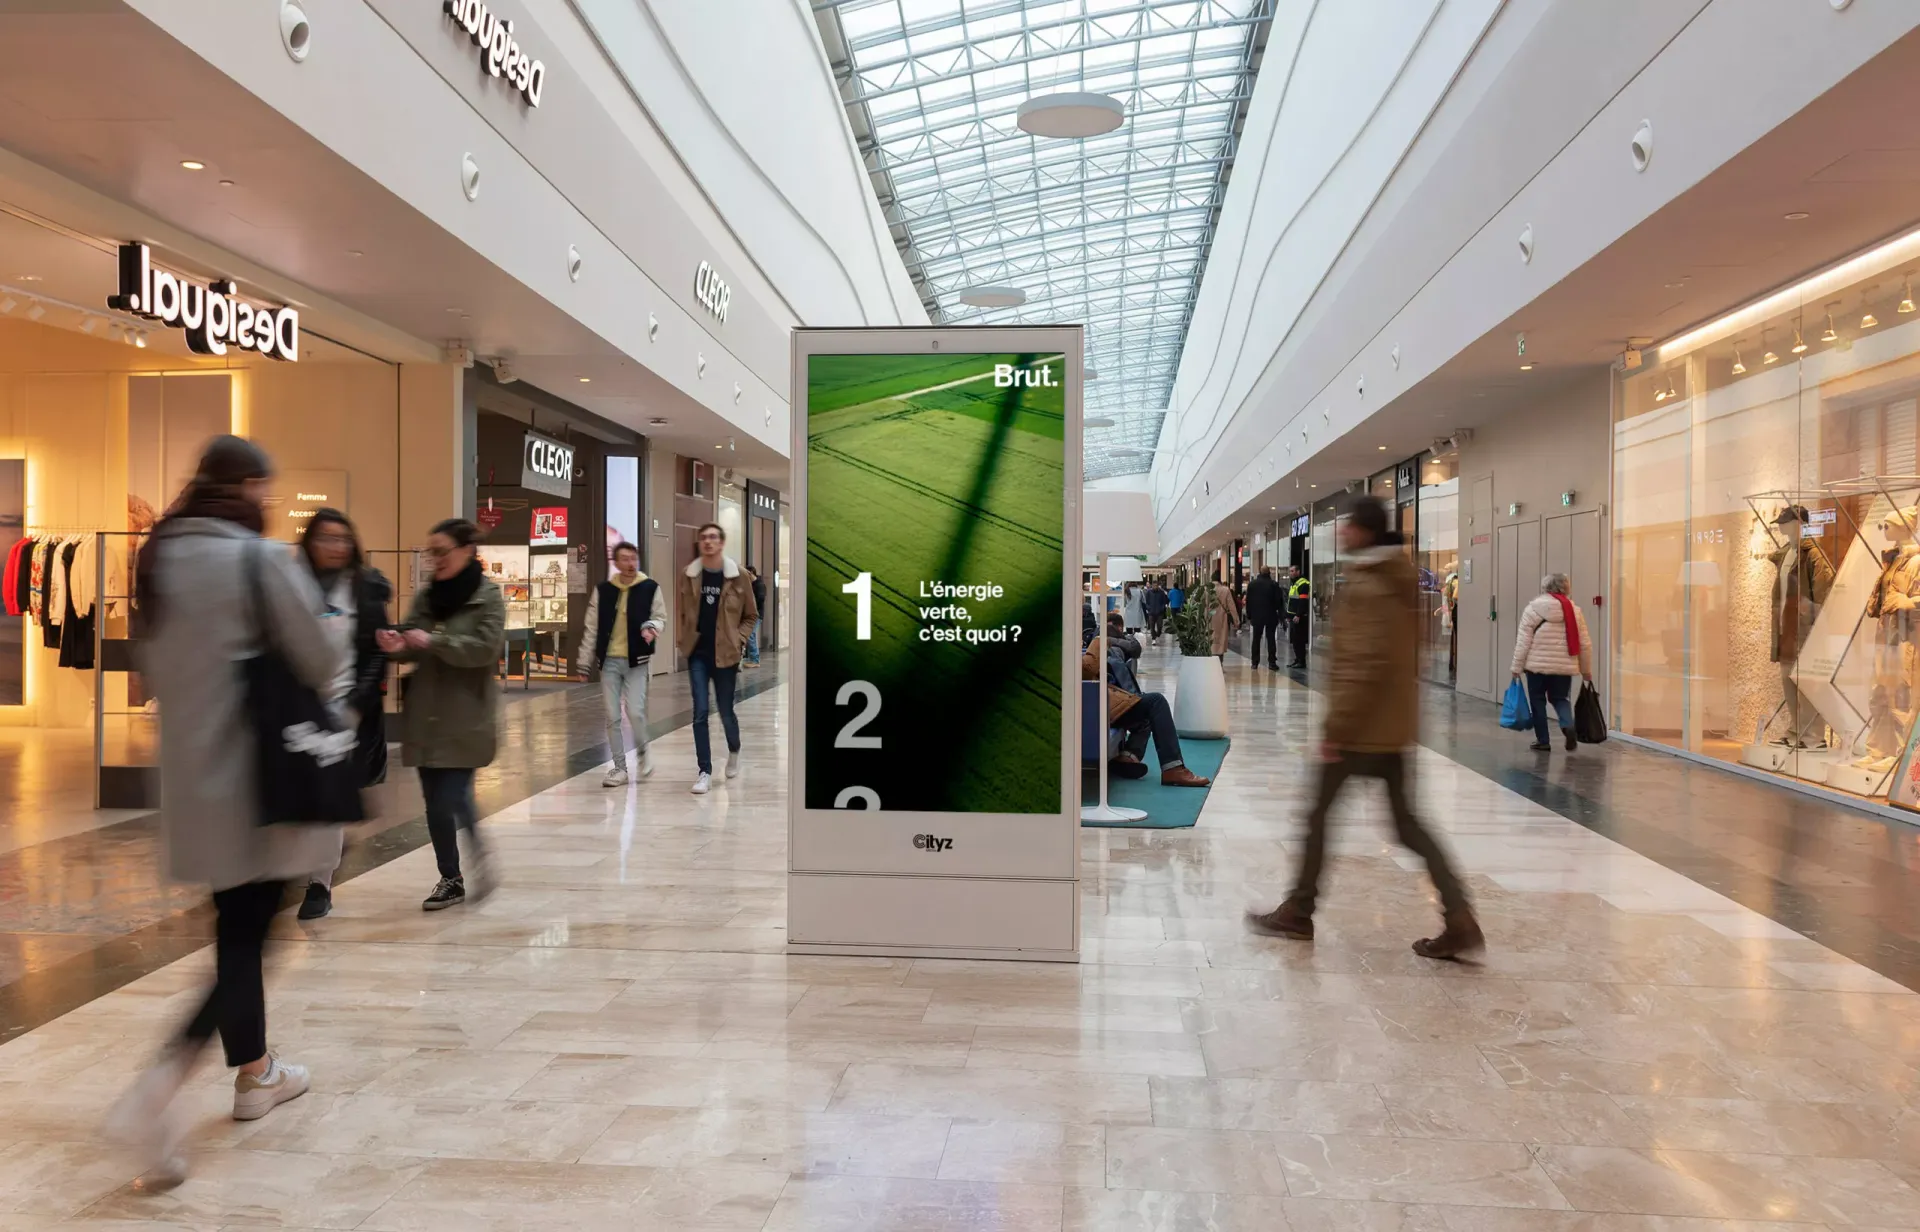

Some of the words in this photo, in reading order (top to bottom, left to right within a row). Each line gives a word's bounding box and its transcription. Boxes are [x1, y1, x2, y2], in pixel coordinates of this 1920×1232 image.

[694, 260, 731, 322] CLEOR
[994, 363, 1058, 387] Brut.
[531, 440, 572, 482] CLEOR
[296, 493, 328, 501] Femme
[754, 493, 775, 510] IZAC
[288, 510, 317, 518] Access
[699, 585, 721, 596] LIFOR
[920, 580, 1004, 601] L'énergie
[842, 572, 871, 640] 1
[919, 603, 972, 622] verte,
[919, 625, 962, 642] c'est
[965, 625, 1007, 645] quoi
[1010, 625, 1022, 642] ?
[834, 679, 882, 749] 2
[912, 833, 953, 853] Cityz
